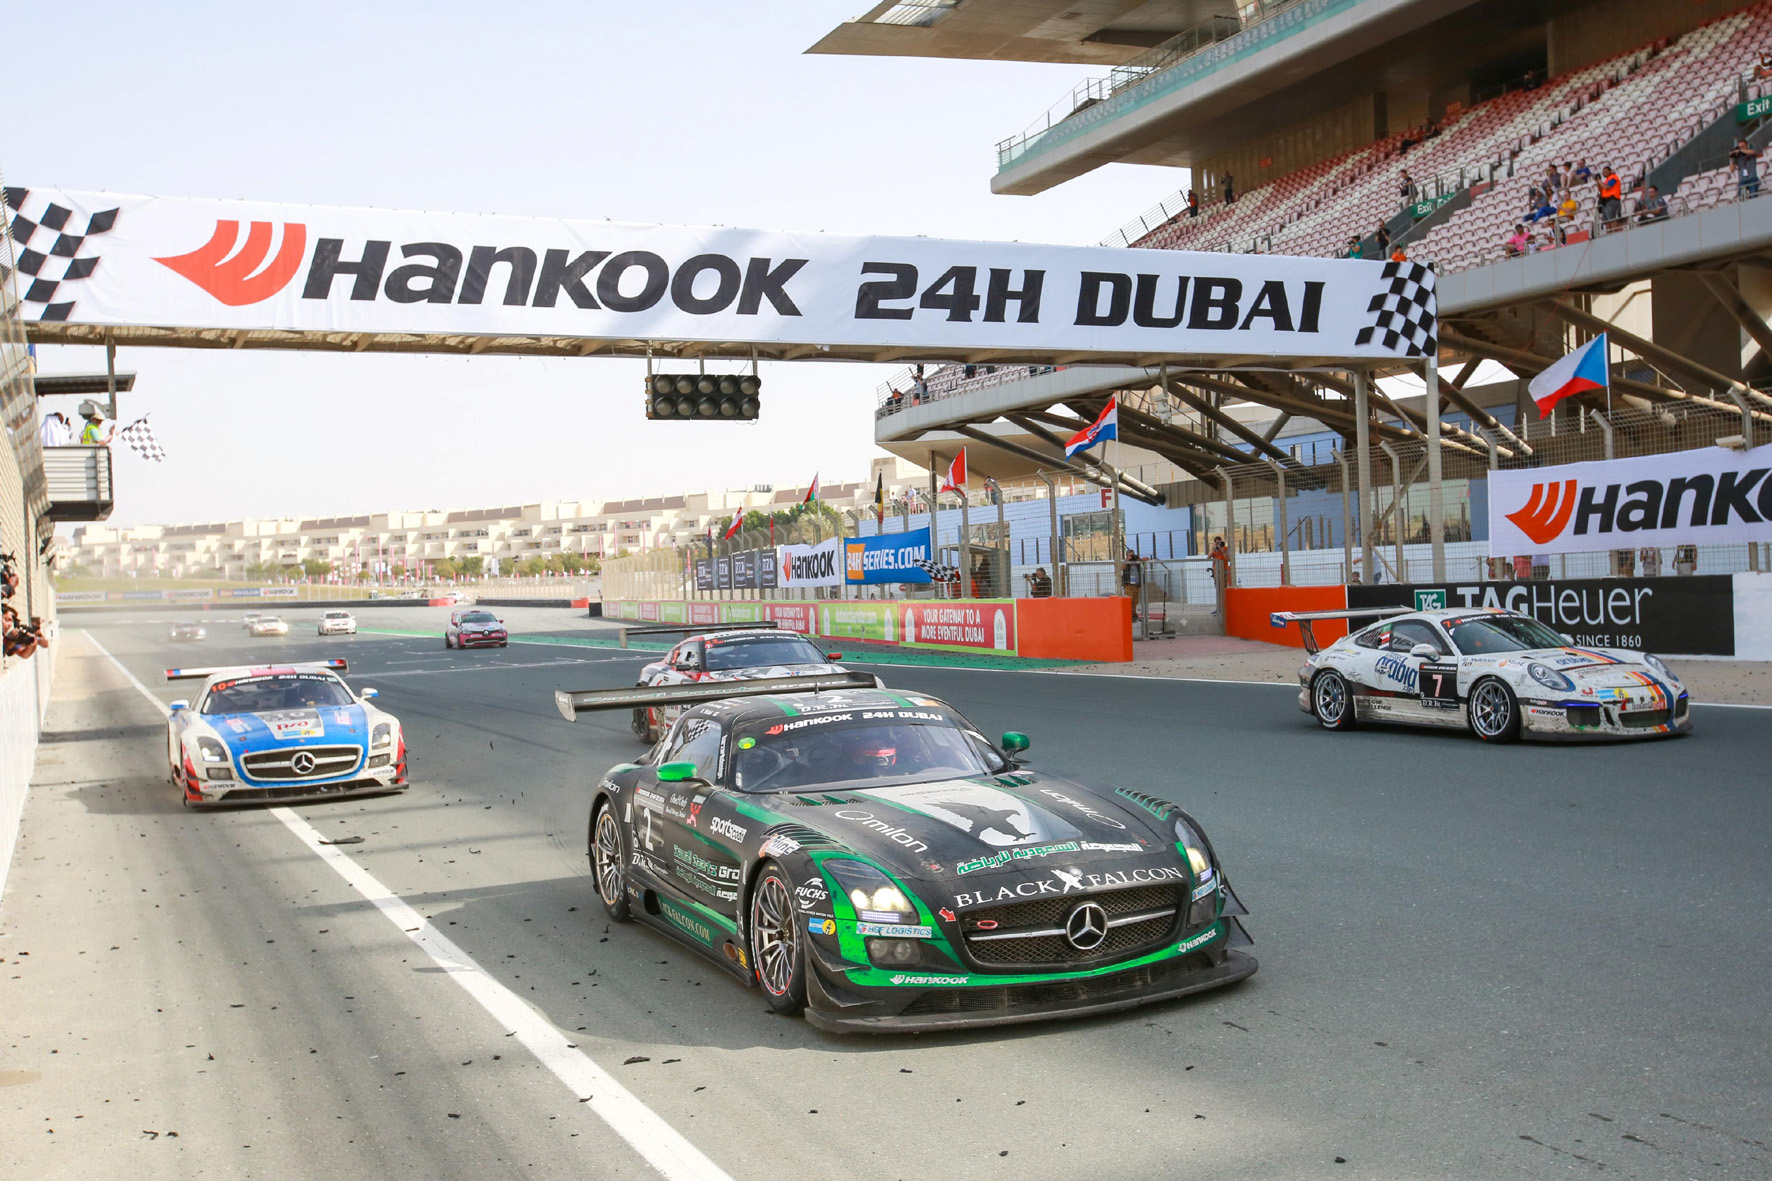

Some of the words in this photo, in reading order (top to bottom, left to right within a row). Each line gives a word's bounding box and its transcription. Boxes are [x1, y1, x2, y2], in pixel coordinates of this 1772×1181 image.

[1747, 98, 1770, 117] Exit
[1418, 202, 1433, 215] Exit
[855, 262, 1046, 324] 24H
[1074, 270, 1325, 333] DUBAI
[1101, 489, 1112, 508] F
[847, 552, 862, 571] 24H
[923, 609, 938, 623] YOUR
[939, 609, 965, 624] GATEWAY
[966, 609, 975, 625] TO
[975, 609, 981, 625] A
[921, 625, 936, 640] MORE
[938, 625, 964, 642] EVENTFUL
[965, 627, 985, 643] DUBAI
[1576, 634, 1610, 647] SINCE
[1615, 635, 1642, 648] 1860
[1432, 674, 1443, 698] 7
[863, 711, 895, 721] 24H
[899, 711, 943, 721] DUBAI
[795, 886, 829, 901] FUCHS
[953, 879, 1061, 909] BLACK
[1086, 867, 1184, 888] FALCON
[886, 926, 932, 936] LOGISTICS
